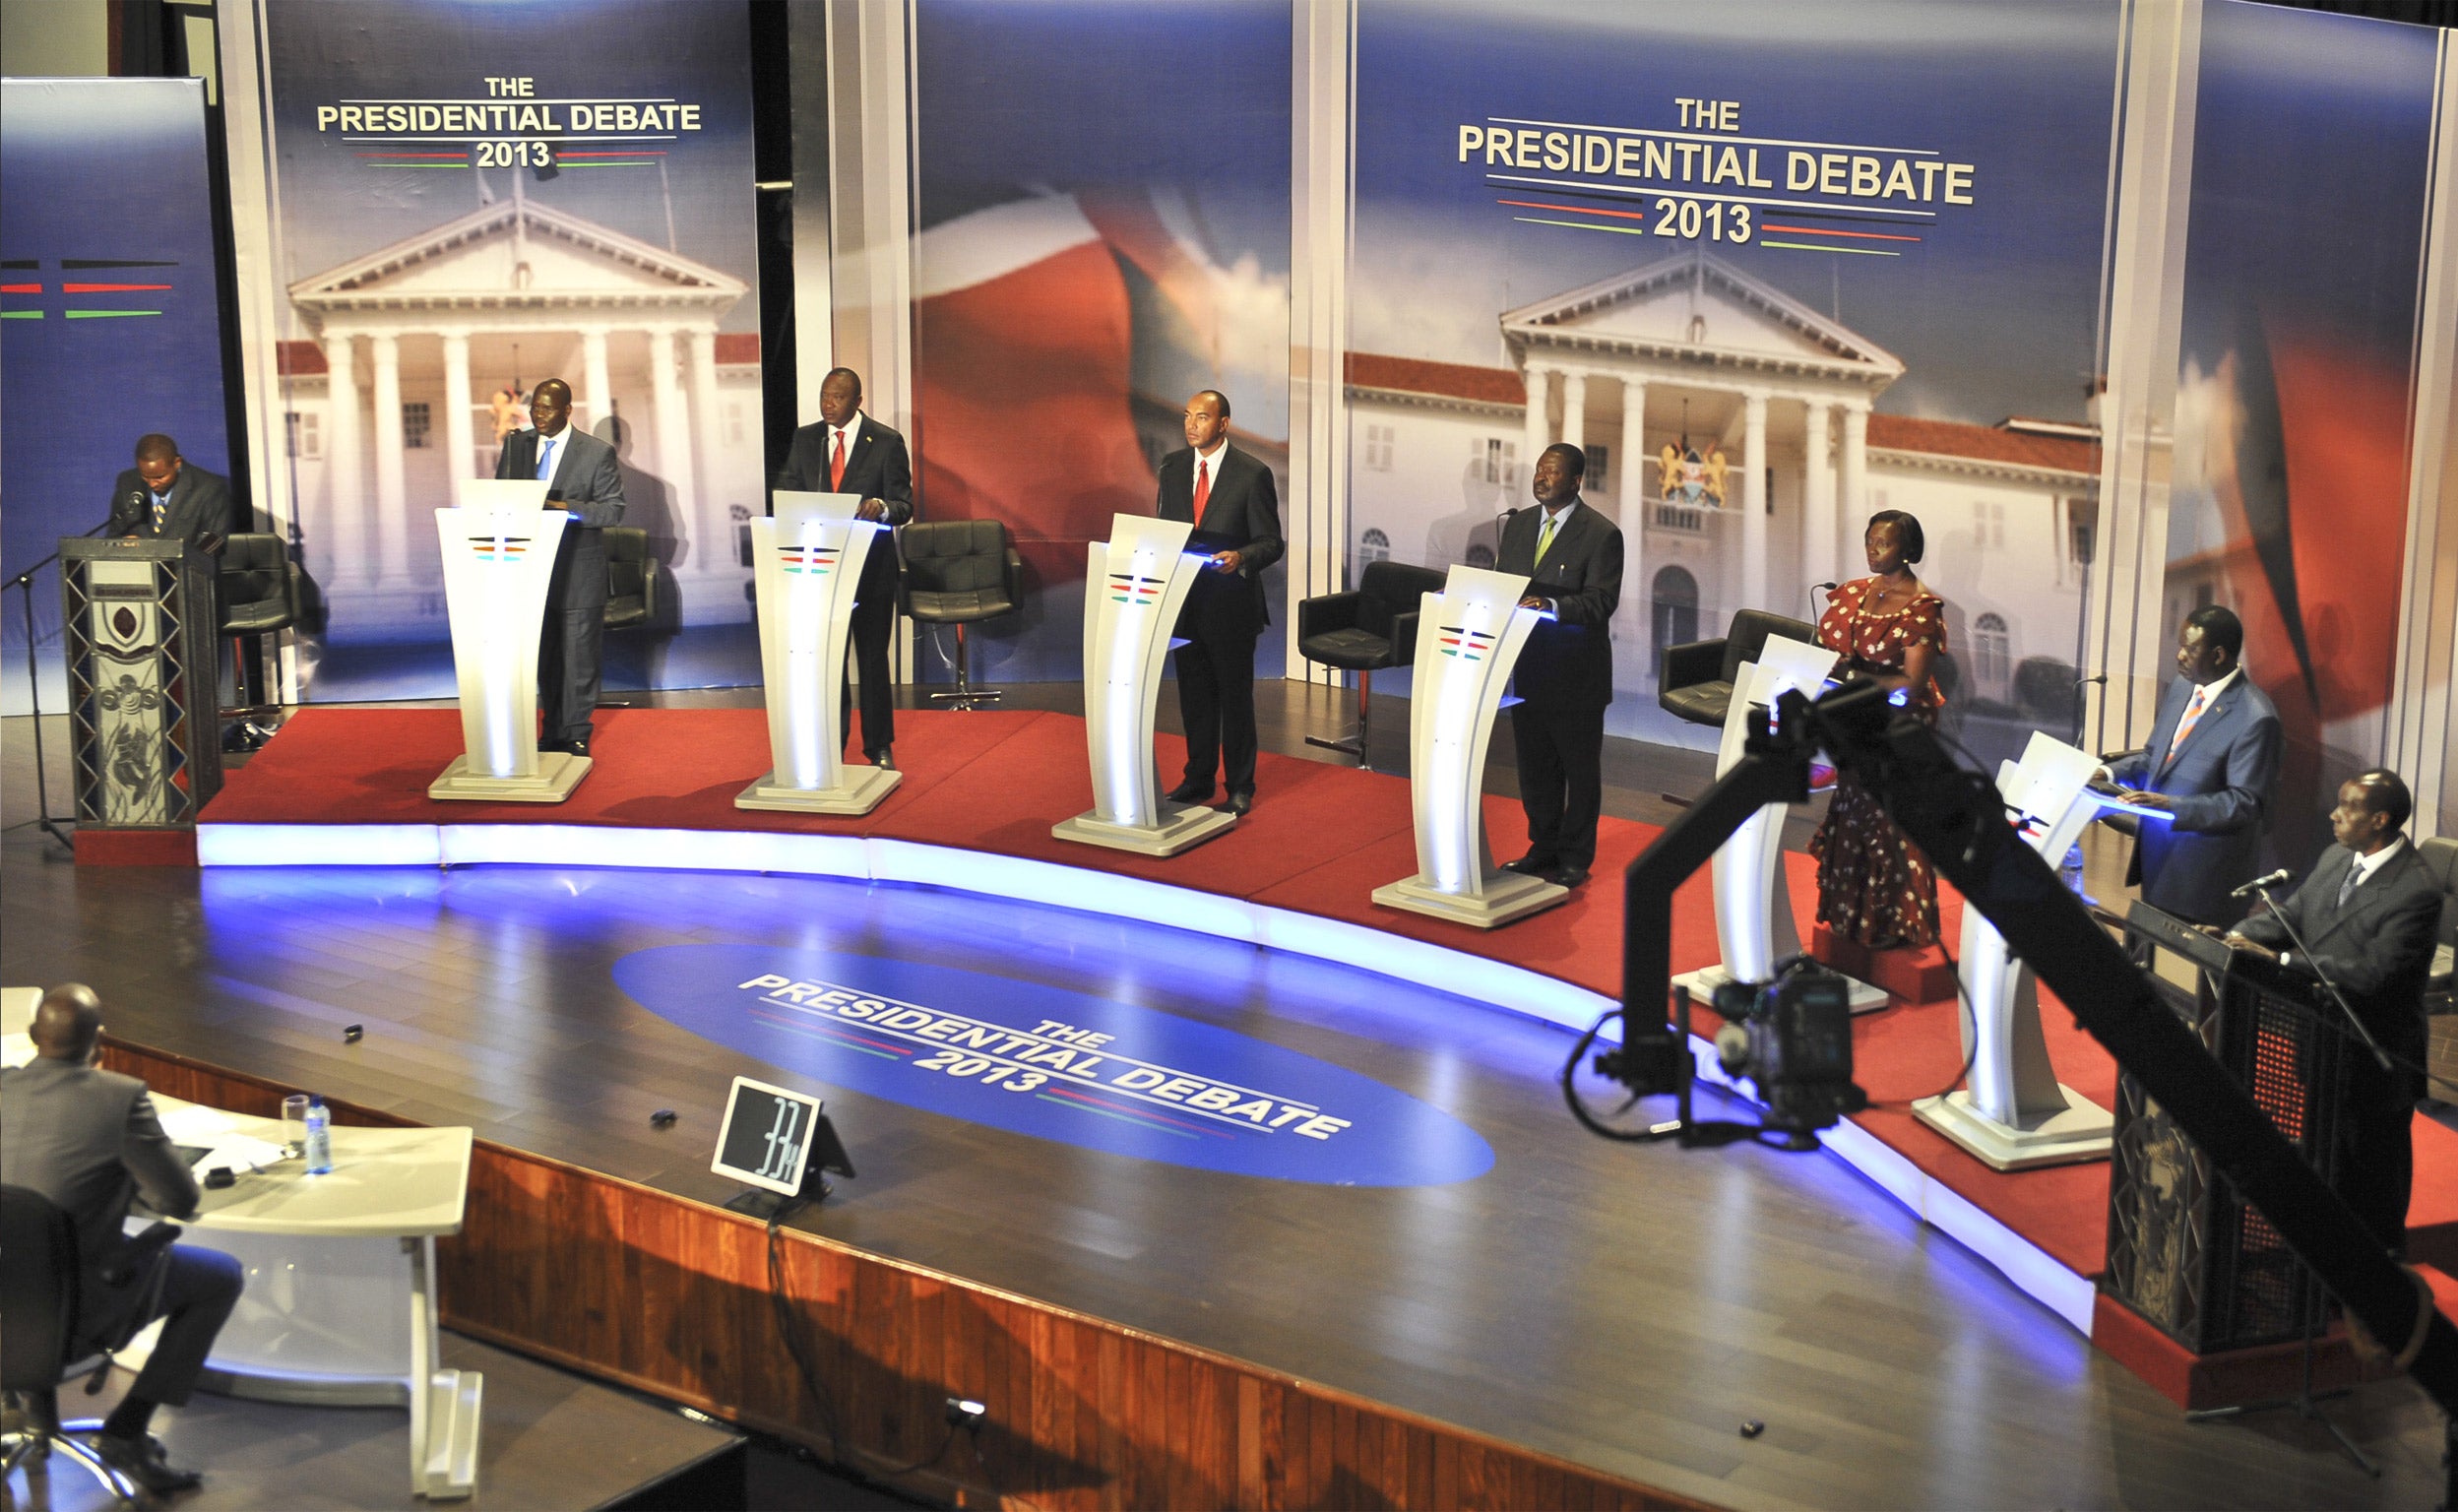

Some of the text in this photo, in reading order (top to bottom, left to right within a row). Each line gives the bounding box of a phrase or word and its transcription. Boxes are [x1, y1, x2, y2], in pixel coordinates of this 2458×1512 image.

[484, 77, 535, 96] THE
[317, 104, 702, 132] PRESIDENTIAL DEBATE
[1674, 97, 1740, 131] THE
[476, 142, 550, 167] 2013
[1459, 124, 1975, 205] PRESIDENTIAL DEBATE
[1654, 197, 1751, 243] 2013
[1031, 1019, 1115, 1050] THE
[738, 973, 1353, 1140] PRESIDENTIAL DEBATE
[913, 1051, 1048, 1094] 2013
